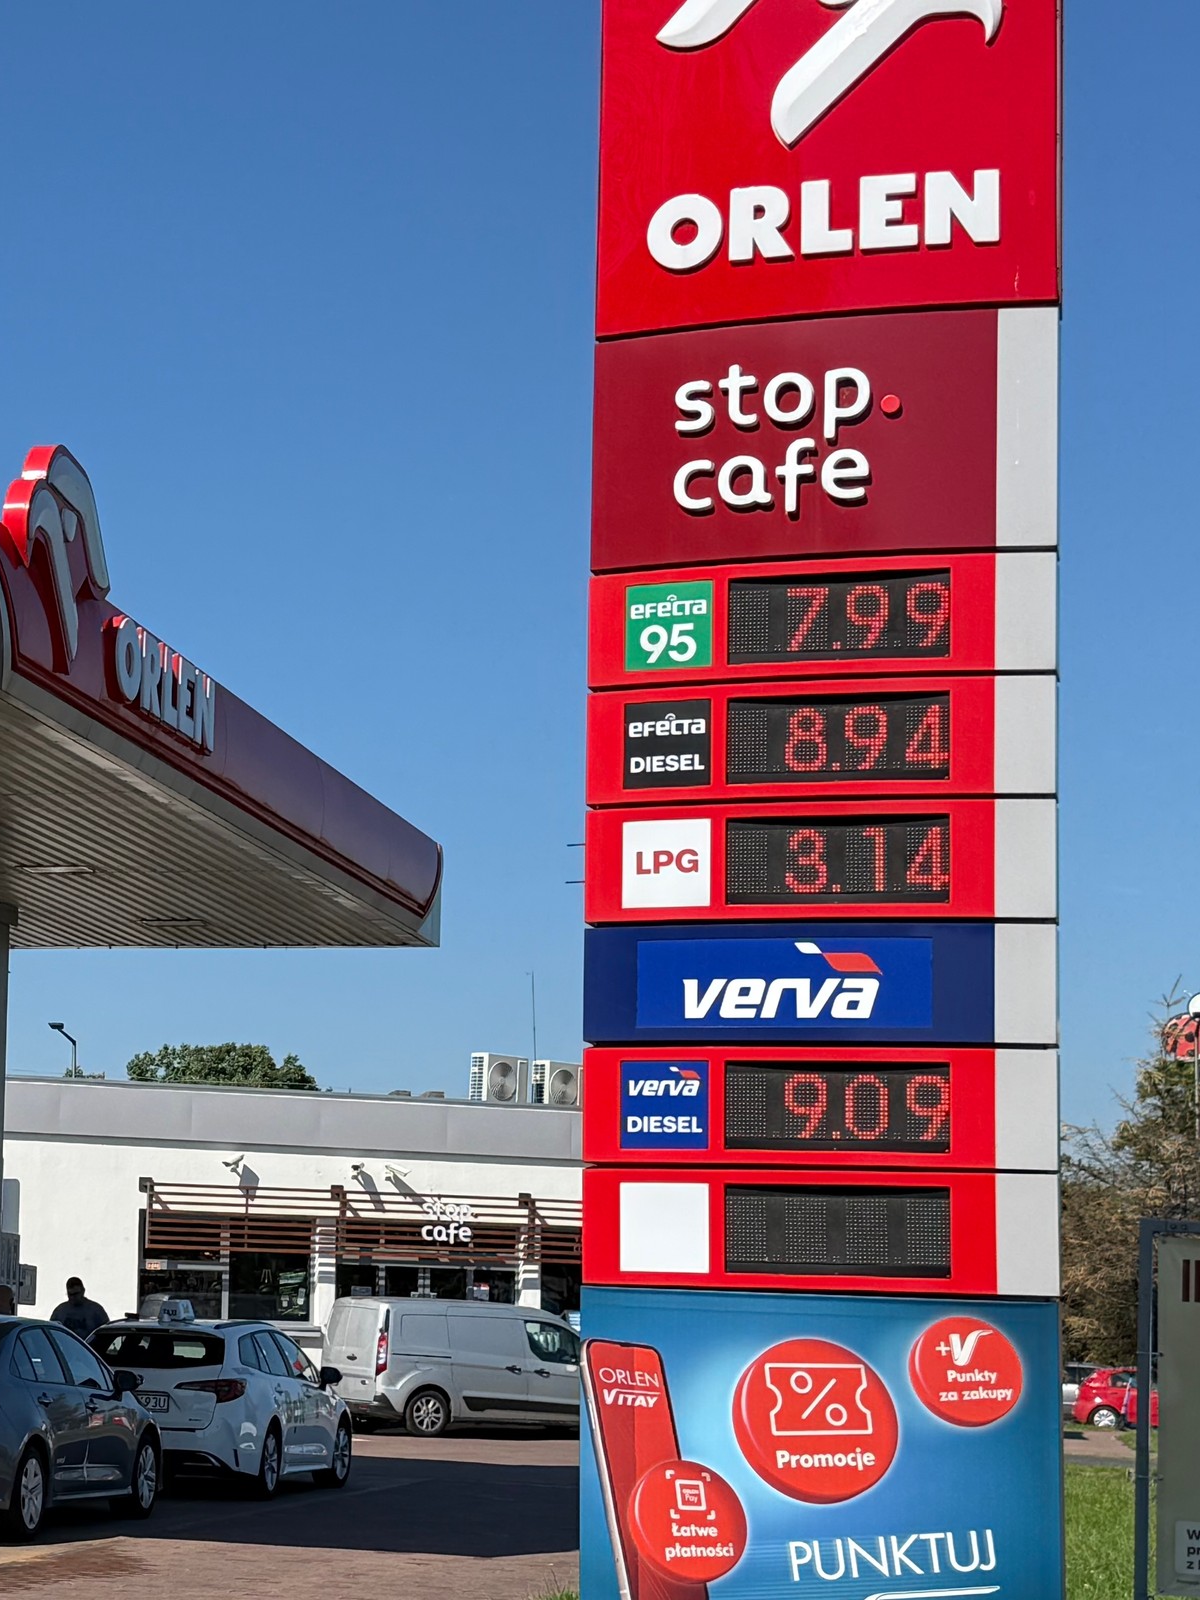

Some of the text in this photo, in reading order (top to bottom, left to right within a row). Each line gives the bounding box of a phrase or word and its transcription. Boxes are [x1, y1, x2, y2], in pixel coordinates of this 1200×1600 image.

[646, 168, 1001, 271] ORLEN
[672, 437, 871, 514] cafe
[786, 582, 950, 652] 7.99
[639, 622, 698, 664] 95
[113, 614, 216, 754] ORLEN
[784, 704, 950, 772] 8.94
[629, 754, 705, 774] DIESEL
[635, 848, 700, 876] LPG
[784, 826, 950, 894] 3.14
[681, 977, 882, 1020] verva
[627, 1077, 701, 1098] verva
[784, 1073, 950, 1140] 9.09
[626, 1115, 703, 1134] DIESEL
[421, 1222, 472, 1245] cafe
[598, 1367, 660, 1388] ORLEN
[946, 1368, 998, 1385] Punkty
[140, 1396, 166, 1408] 93U
[938, 1385, 1013, 1402] za zakupy
[775, 1446, 876, 1472] Promocje
[684, 1493, 698, 1503] Pay
[671, 1522, 718, 1537] Łatwe
[664, 1542, 735, 1562] płatności
[787, 1529, 997, 1582] PUNKTUJ
